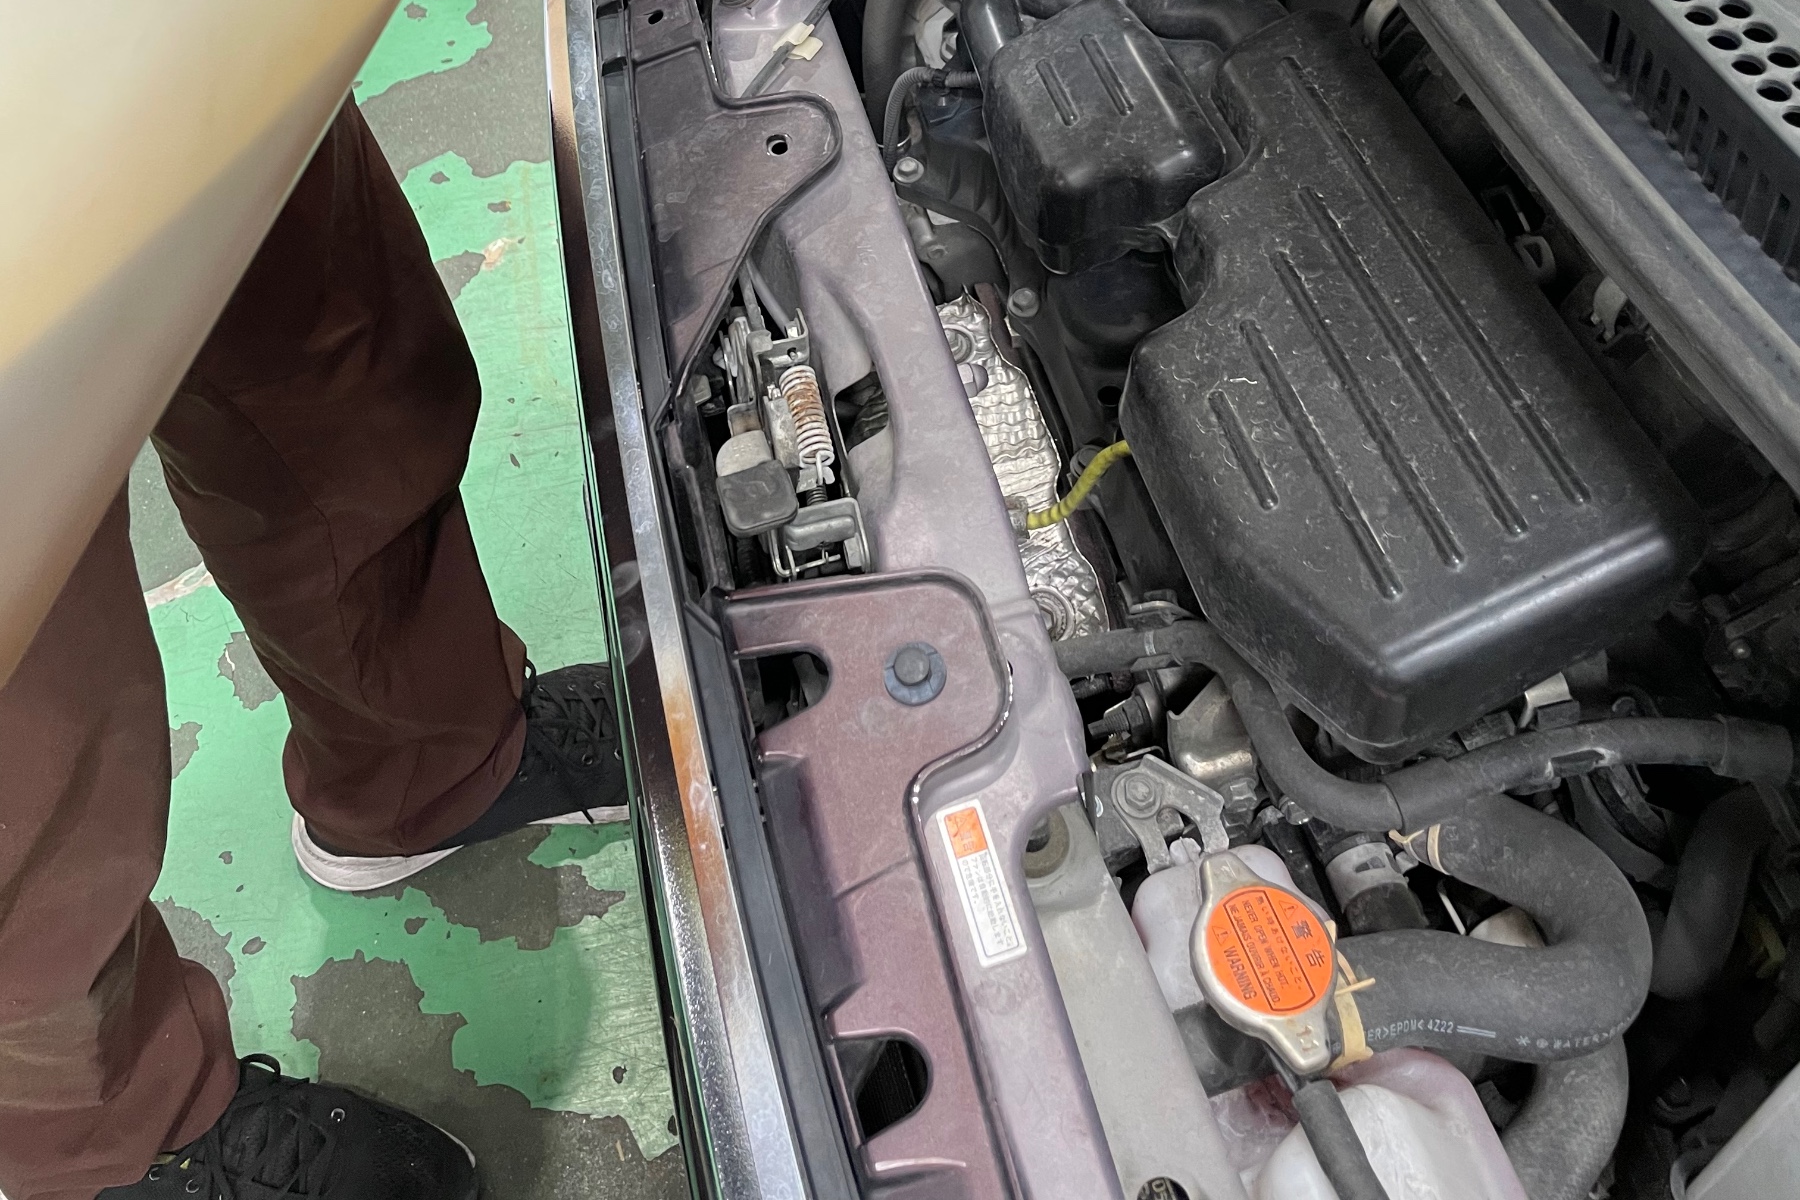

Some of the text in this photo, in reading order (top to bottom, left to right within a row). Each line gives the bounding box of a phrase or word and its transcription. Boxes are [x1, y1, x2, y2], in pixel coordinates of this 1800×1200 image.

[1227, 902, 1239, 914] NE
[1231, 912, 1252, 942] JAMAIS
[1240, 898, 1259, 924] NEVER
[1252, 922, 1269, 946] OPEN
[1262, 944, 1280, 969] WHEN
[1289, 916, 1328, 972] 警告
[1220, 944, 1259, 1002] WARNING
[1427, 1019, 1454, 1034] 4Z22
